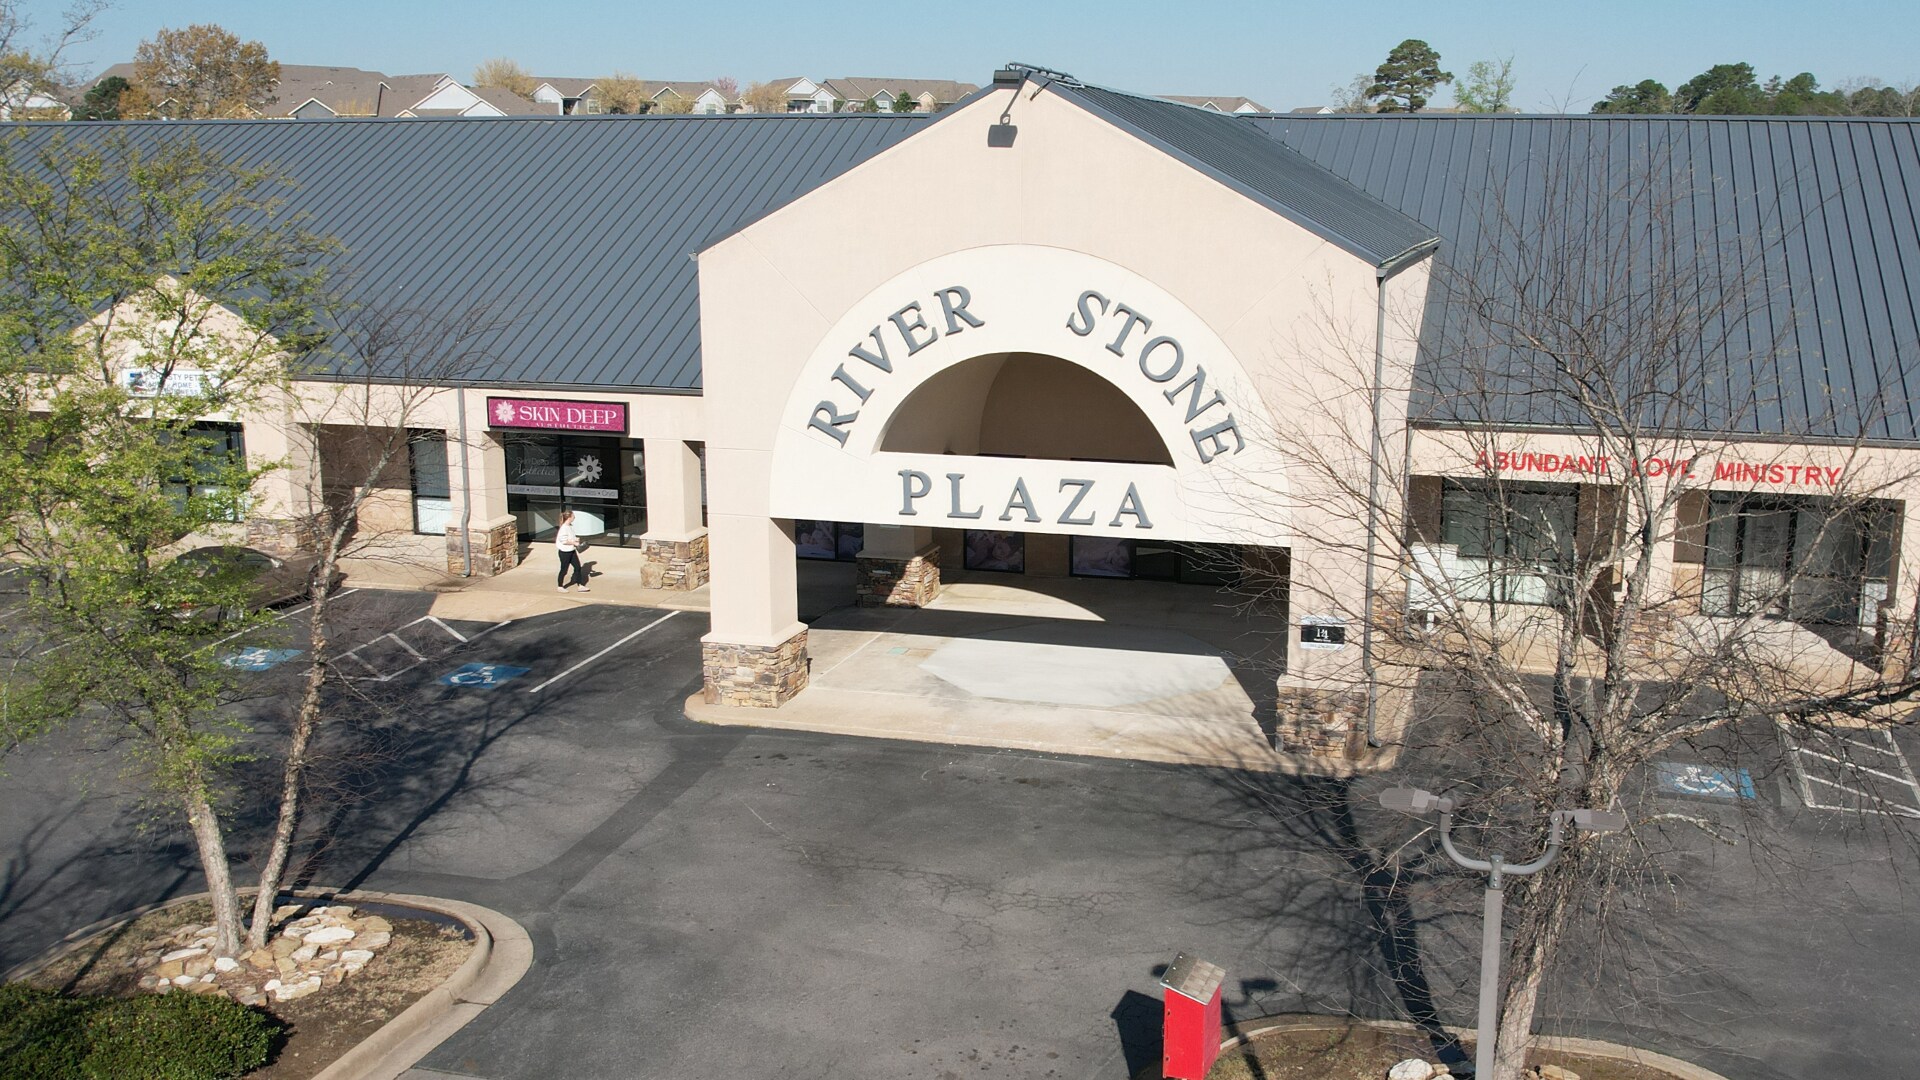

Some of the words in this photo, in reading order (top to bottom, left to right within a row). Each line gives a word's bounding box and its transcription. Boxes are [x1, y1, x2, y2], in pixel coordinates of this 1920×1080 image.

[807, 285, 985, 448] RIVER
[1066, 289, 1246, 465] STONE
[520, 405, 560, 422] SKIN
[567, 407, 617, 425] DEEP
[1474, 450, 1611, 475] ABUNDANT
[1716, 461, 1842, 486] MINISTRY
[898, 469, 1154, 529] PLAZA
